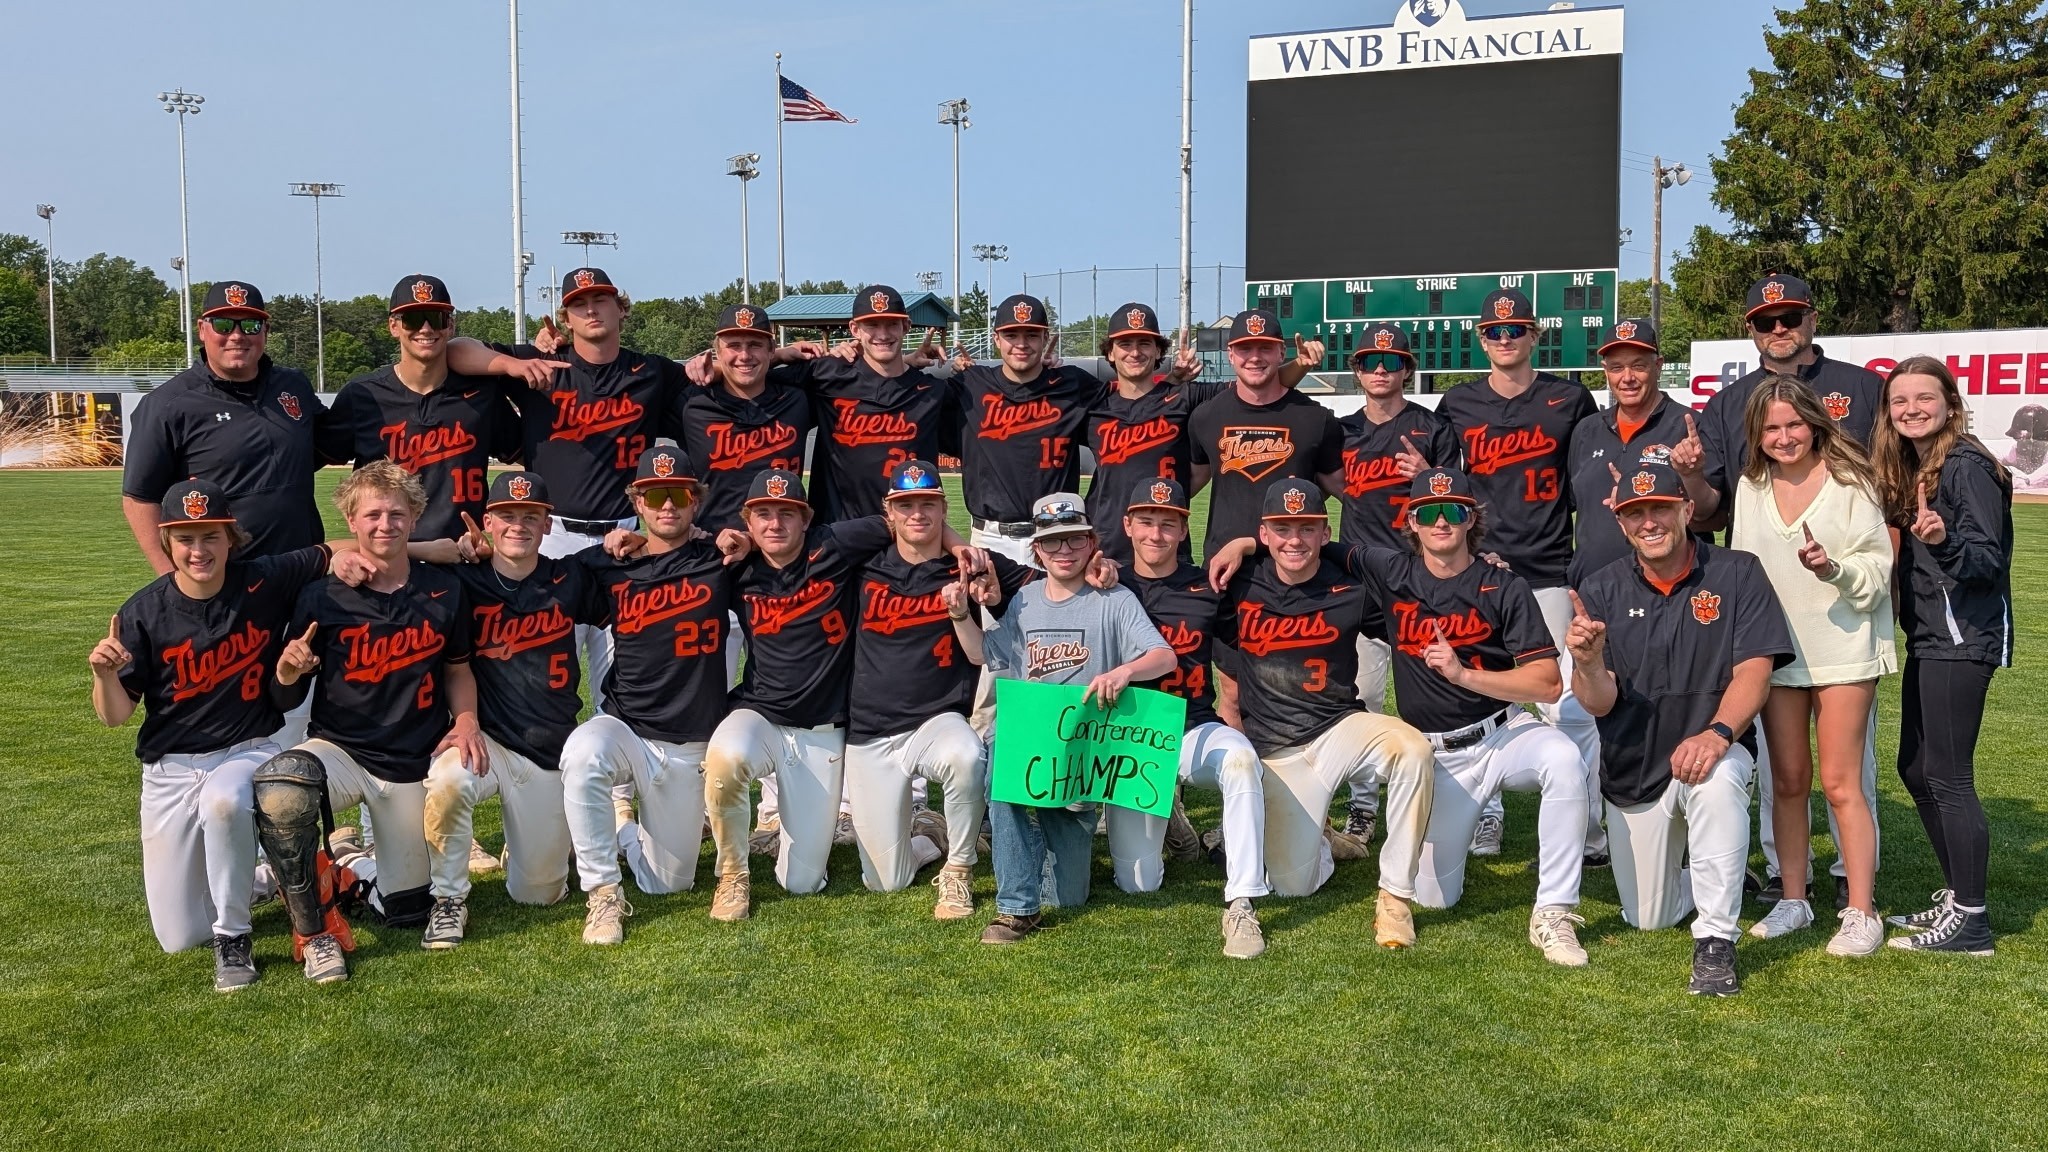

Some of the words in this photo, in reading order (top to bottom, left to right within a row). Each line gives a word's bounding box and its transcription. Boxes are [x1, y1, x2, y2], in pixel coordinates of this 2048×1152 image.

[1277, 34, 1383, 73] WNB
[1397, 27, 1592, 65] FINANCIAL
[1258, 285, 1271, 296] AT
[1273, 283, 1294, 296] BAT
[1345, 281, 1374, 293] BALL
[1416, 277, 1457, 291] STRIKE
[1500, 275, 1524, 288] OUT
[1573, 273, 1594, 286] H/E
[1315, 324, 1321, 334] 1
[1330, 324, 1336, 333] 2
[1345, 323, 1351, 333] 3
[1412, 321, 1419, 331] 7
[1428, 320, 1434, 331] 8
[1443, 320, 1450, 331] 9
[1460, 320, 1473, 331] 10
[1539, 317, 1563, 328] HITS
[1582, 316, 1603, 327] ERR
[550, 390, 644, 442] Tigers
[833, 398, 917, 447] Tigers
[978, 393, 1061, 440] Tigers
[380, 420, 476, 474] Tigers
[615, 435, 645, 469] 12
[706, 420, 797, 470] Tigers
[1039, 437, 1070, 469] 15
[1097, 415, 1179, 465] Tigers
[1219, 434, 1292, 468] Tigers
[1463, 424, 1557, 475] Tigers
[450, 468, 484, 503] 16
[1158, 456, 1176, 480] 6
[1524, 468, 1558, 502] 13
[1389, 496, 1411, 529] 7
[611, 578, 711, 634] Tigers
[473, 602, 573, 661] Tigers
[674, 618, 720, 657] 23
[820, 610, 847, 645] 9
[1237, 600, 1340, 657] Tigers
[1392, 600, 1493, 660] Tigers
[163, 620, 270, 703] Tigers
[340, 619, 446, 684] Tigers
[933, 634, 953, 667] 4
[1026, 638, 1088, 674] Tigers
[1042, 660, 1075, 672] BASEBALL
[241, 663, 264, 702] 8
[549, 653, 569, 689] 5
[1160, 664, 1206, 699] 24
[1302, 658, 1328, 692] 3
[417, 671, 434, 710] 2
[1057, 705, 1177, 751] Conference
[1025, 753, 1160, 809] CHAMPS
